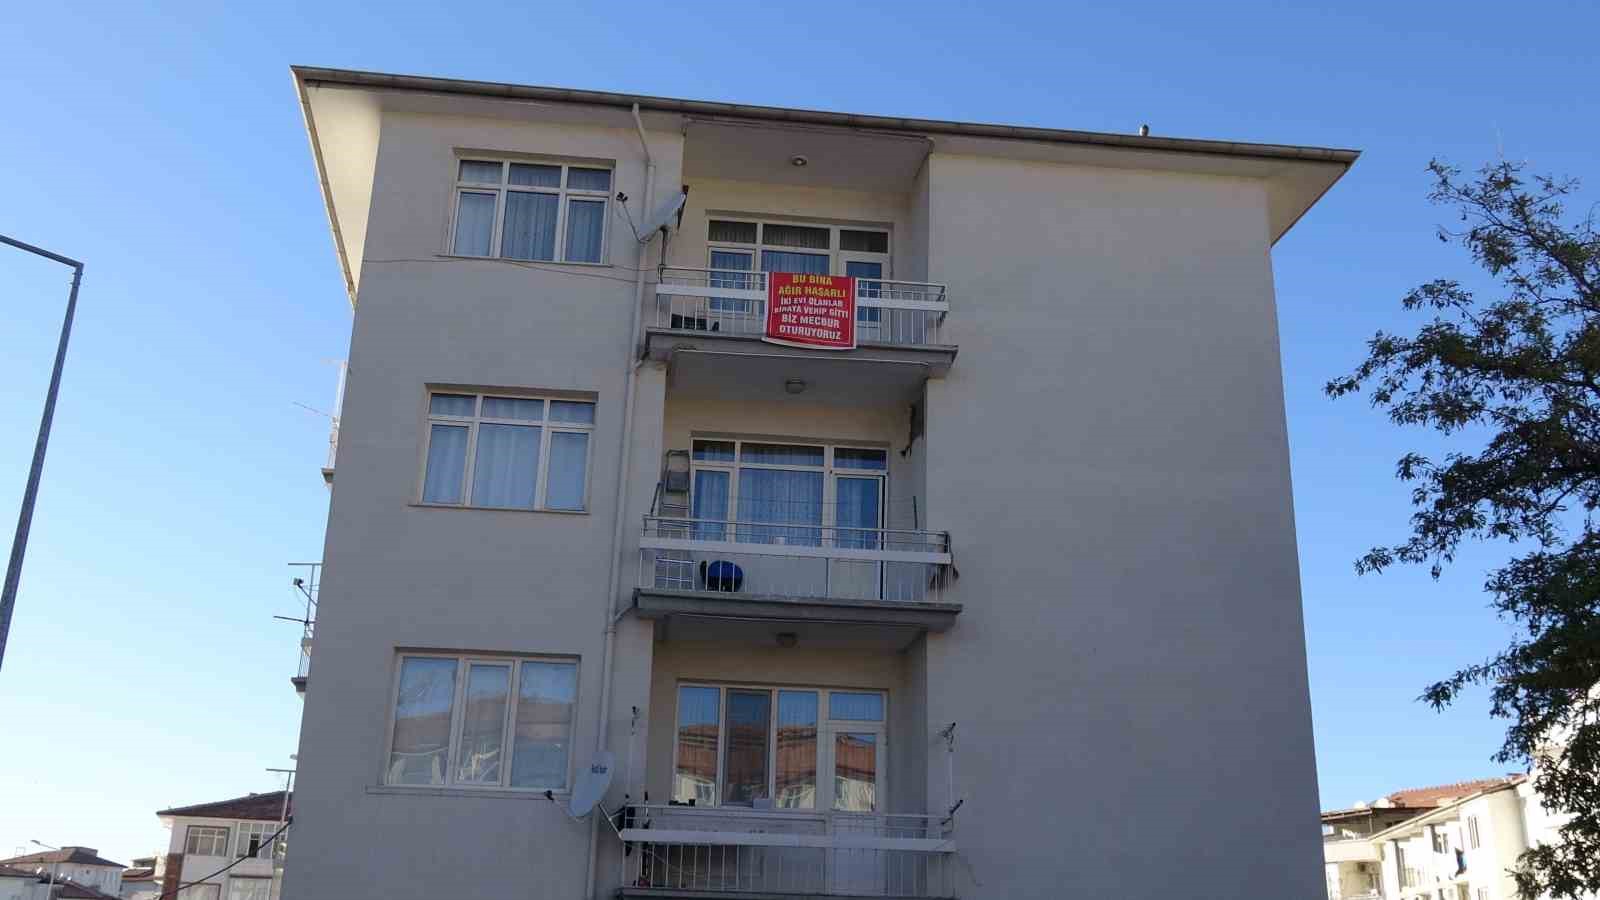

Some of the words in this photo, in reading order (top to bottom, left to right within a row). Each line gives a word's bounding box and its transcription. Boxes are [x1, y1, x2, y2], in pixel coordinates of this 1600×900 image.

[792, 274, 806, 284] BU
[804, 286, 847, 298] HASARLI
[779, 325, 841, 340] OTURUYORUZ
